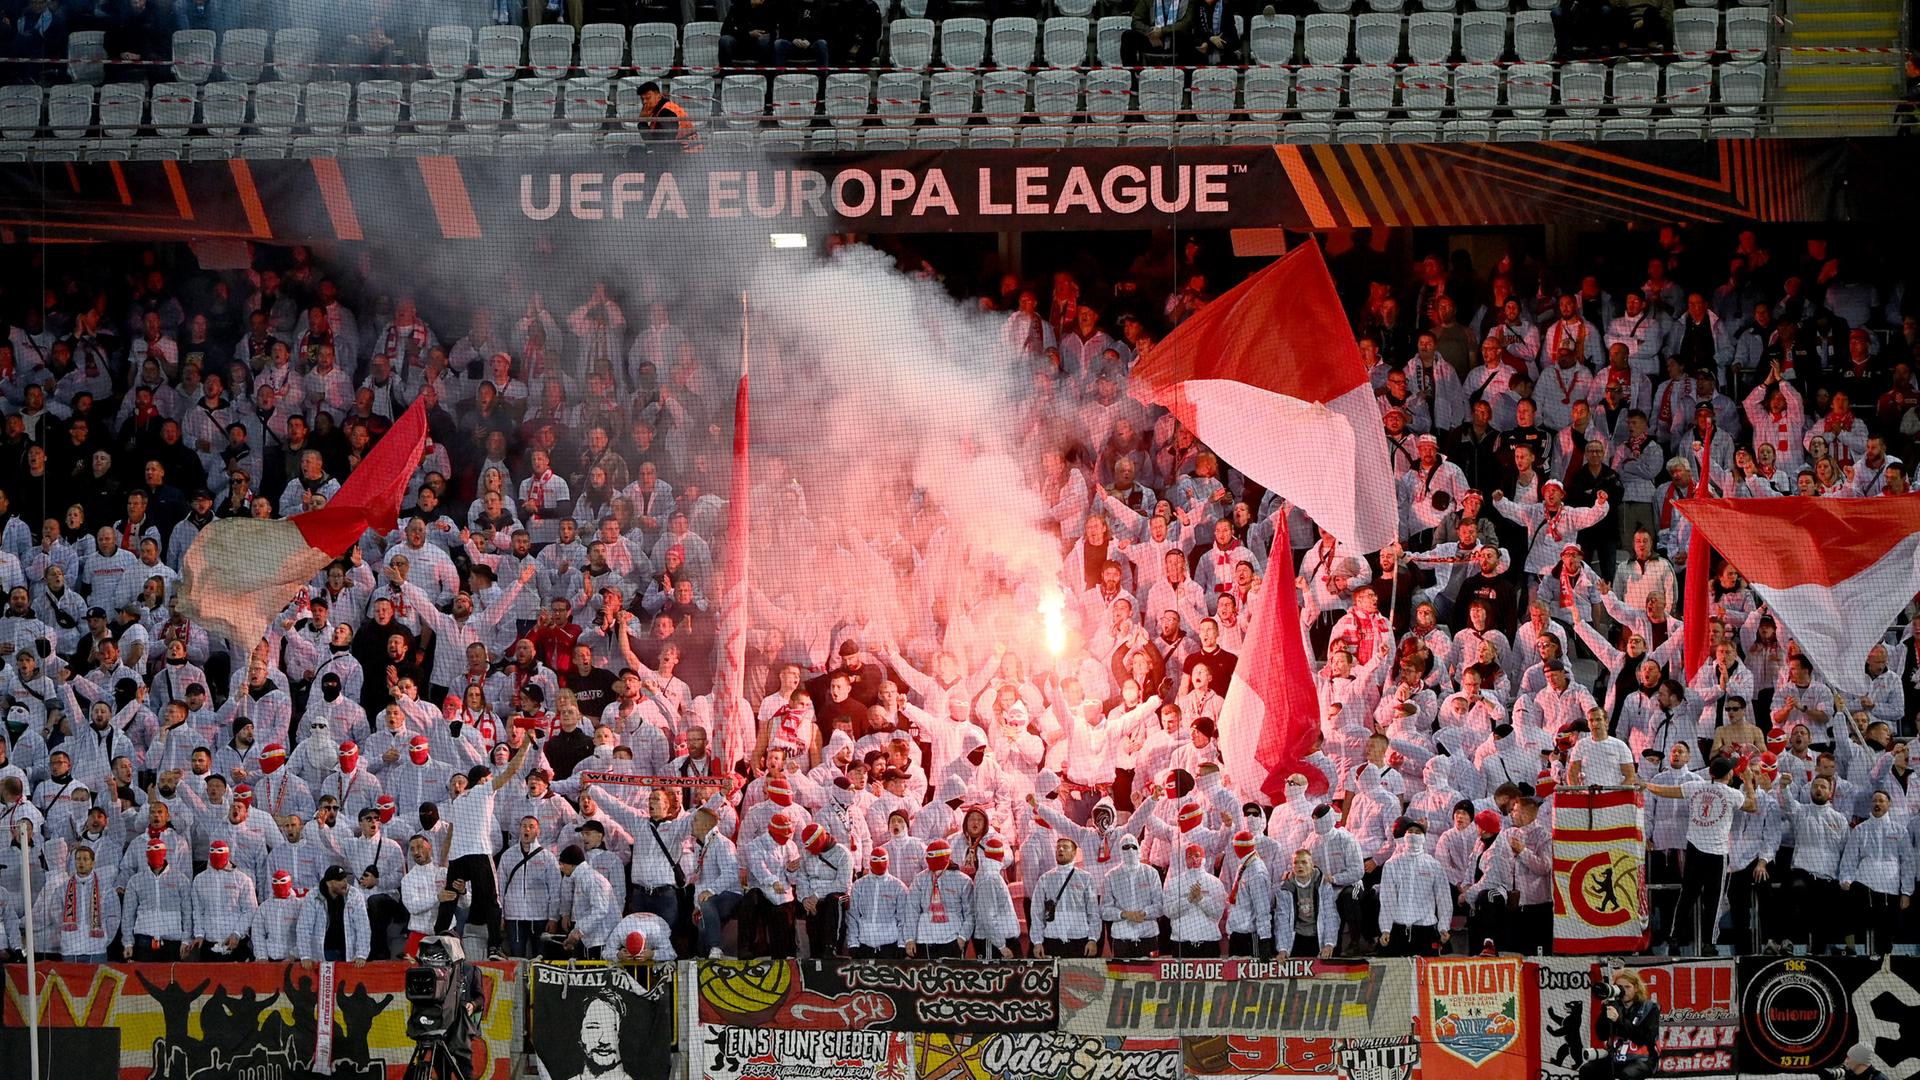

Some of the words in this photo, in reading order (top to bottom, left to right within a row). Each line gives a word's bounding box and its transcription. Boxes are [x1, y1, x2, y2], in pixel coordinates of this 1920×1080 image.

[520, 172, 689, 220] UEFA
[707, 168, 960, 218] EUROPA
[978, 164, 1229, 215] LEAGUE
[1161, 961, 1223, 980] BRIGADE
[1237, 959, 1314, 979] KÖPENICK
[1431, 963, 1517, 995] UNION
[1783, 960, 1807, 972] 1966
[727, 1027, 771, 1056] EINS
[822, 1029, 887, 1061] SIEBEN
[984, 1034, 1070, 1077] Oder
[1341, 1043, 1418, 1070] PLATTE
[1659, 1050, 1732, 1072] enick
